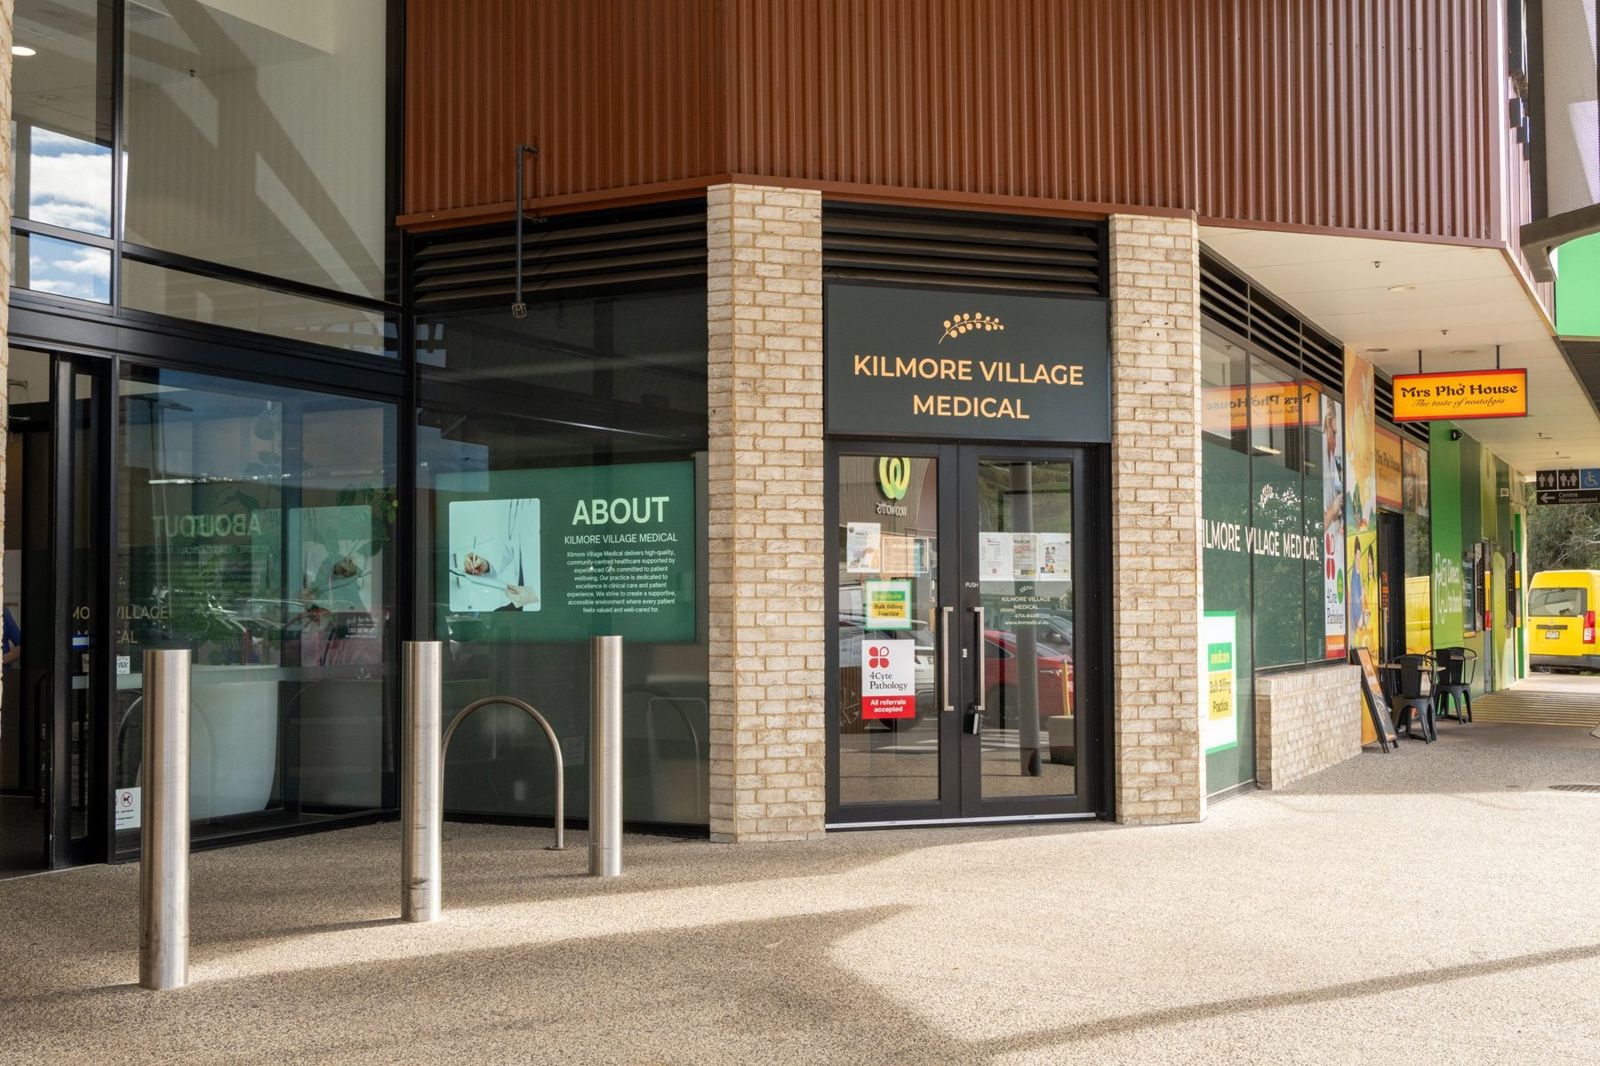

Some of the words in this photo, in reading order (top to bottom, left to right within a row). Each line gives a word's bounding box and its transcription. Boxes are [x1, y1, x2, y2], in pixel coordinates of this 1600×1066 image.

[854, 354, 973, 380] KILMORE
[979, 360, 1084, 386] VILLAGE
[1401, 387, 1431, 398] Mrs
[1469, 384, 1518, 395] House
[913, 394, 1029, 419] MEDICAL
[1412, 399, 1430, 407] The
[1431, 399, 1450, 407] taste
[1453, 398, 1464, 408] of
[1465, 397, 1504, 407] nostalgia
[572, 496, 670, 525] ABOUT
[564, 535, 600, 544] KILMORE
[603, 533, 637, 543] VILLAGE
[640, 532, 678, 542] MEDICAL
[1283, 532, 1320, 561] MEDICAL
[869, 671, 893, 681] 4Cyte
[869, 680, 908, 691] Pathology
[880, 698, 907, 706] referrals
